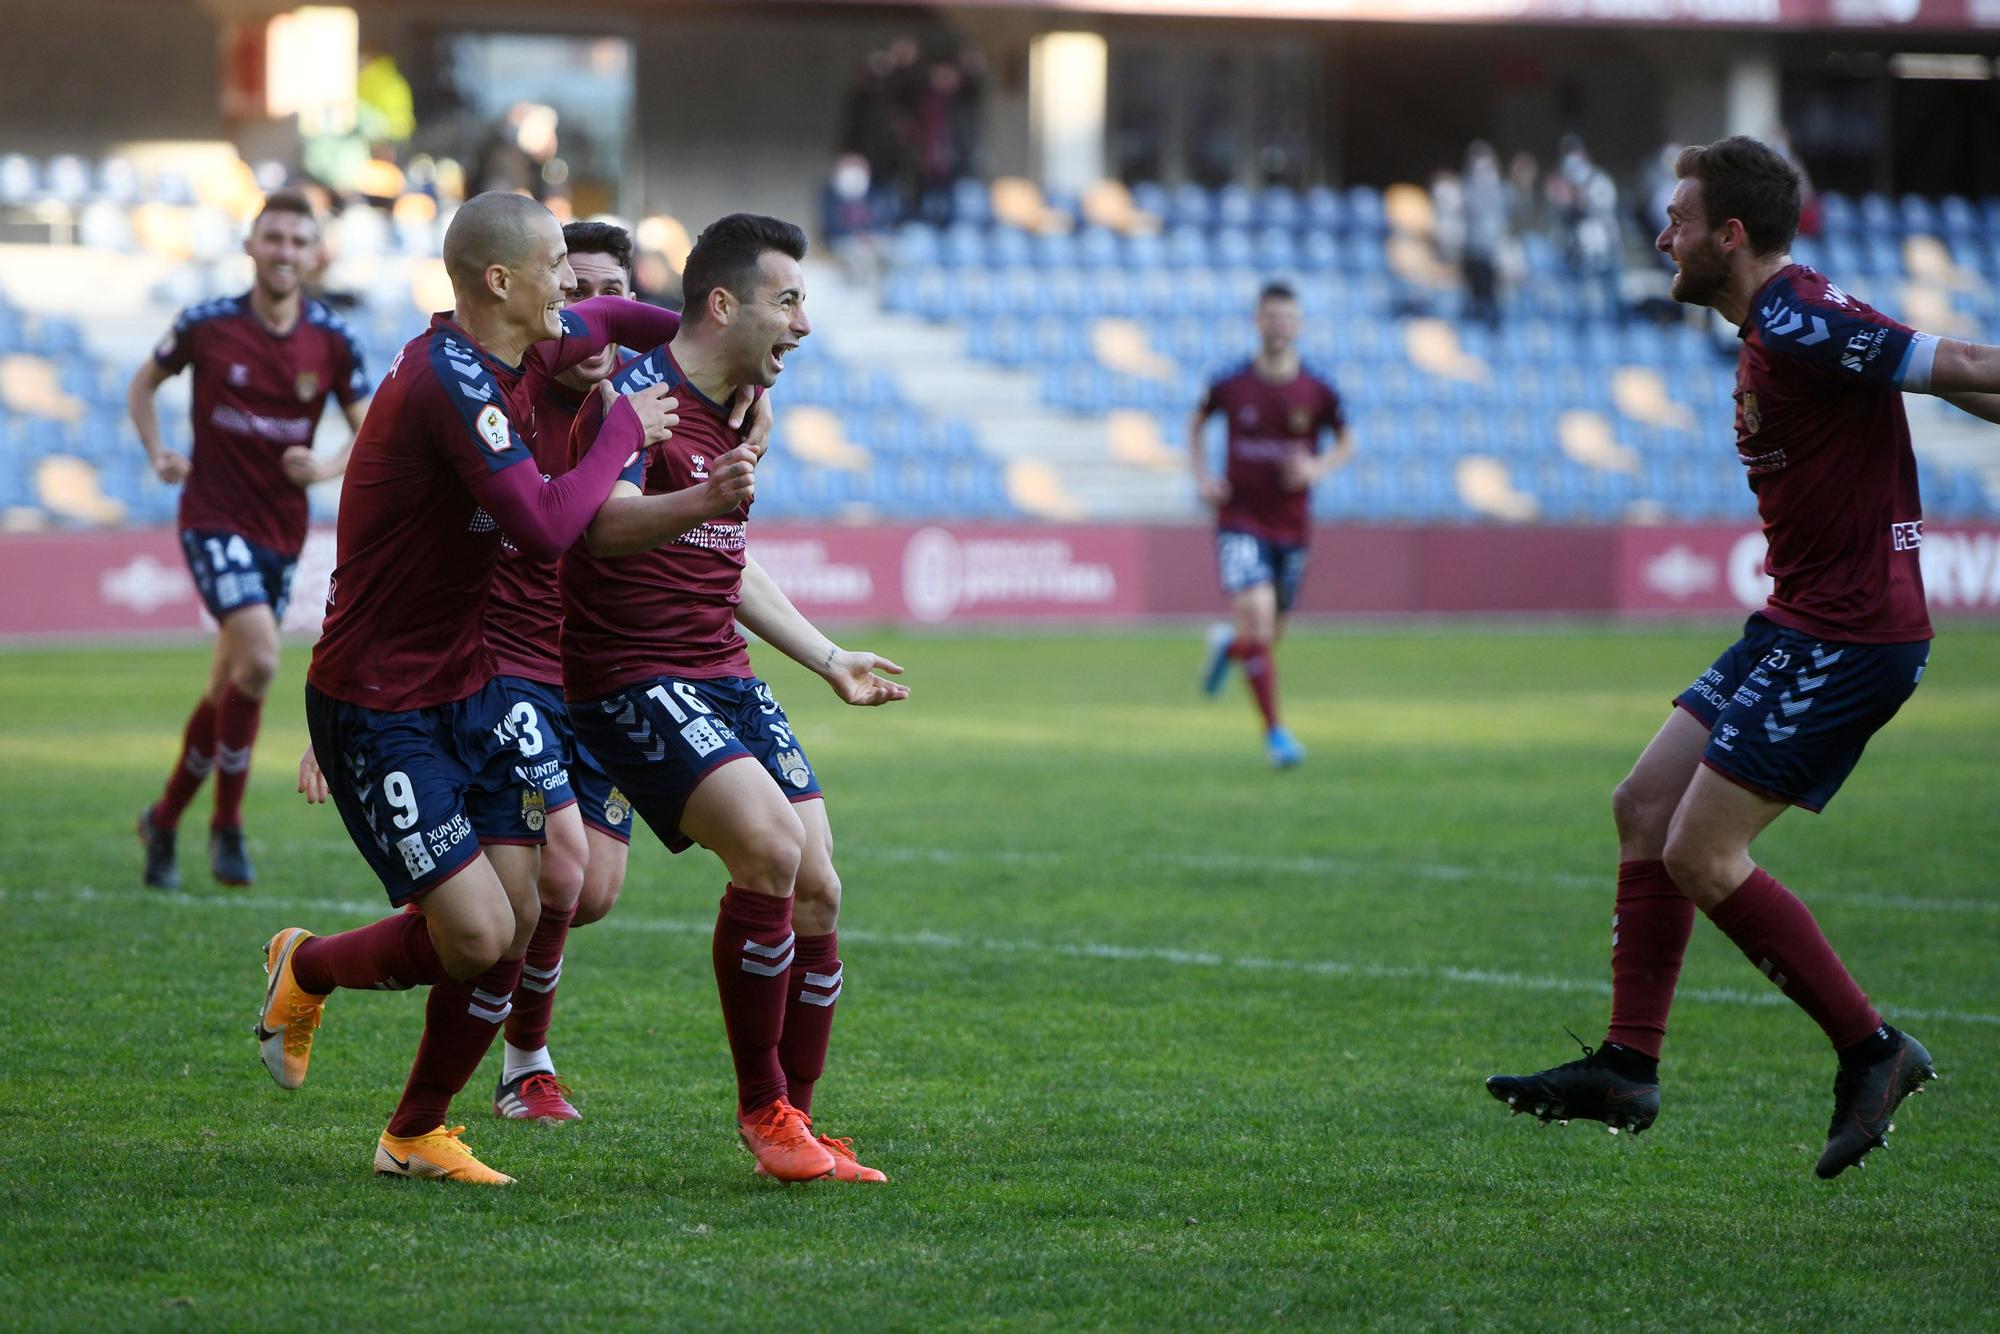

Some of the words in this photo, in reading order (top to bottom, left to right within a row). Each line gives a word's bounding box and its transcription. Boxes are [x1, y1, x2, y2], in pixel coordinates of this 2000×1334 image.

[205, 534, 253, 572] 14
[646, 682, 712, 724] 16
[525, 760, 558, 779] UNTA
[383, 771, 419, 830] 9
[427, 813, 465, 845] XUNTA
[432, 839, 451, 858] DE
